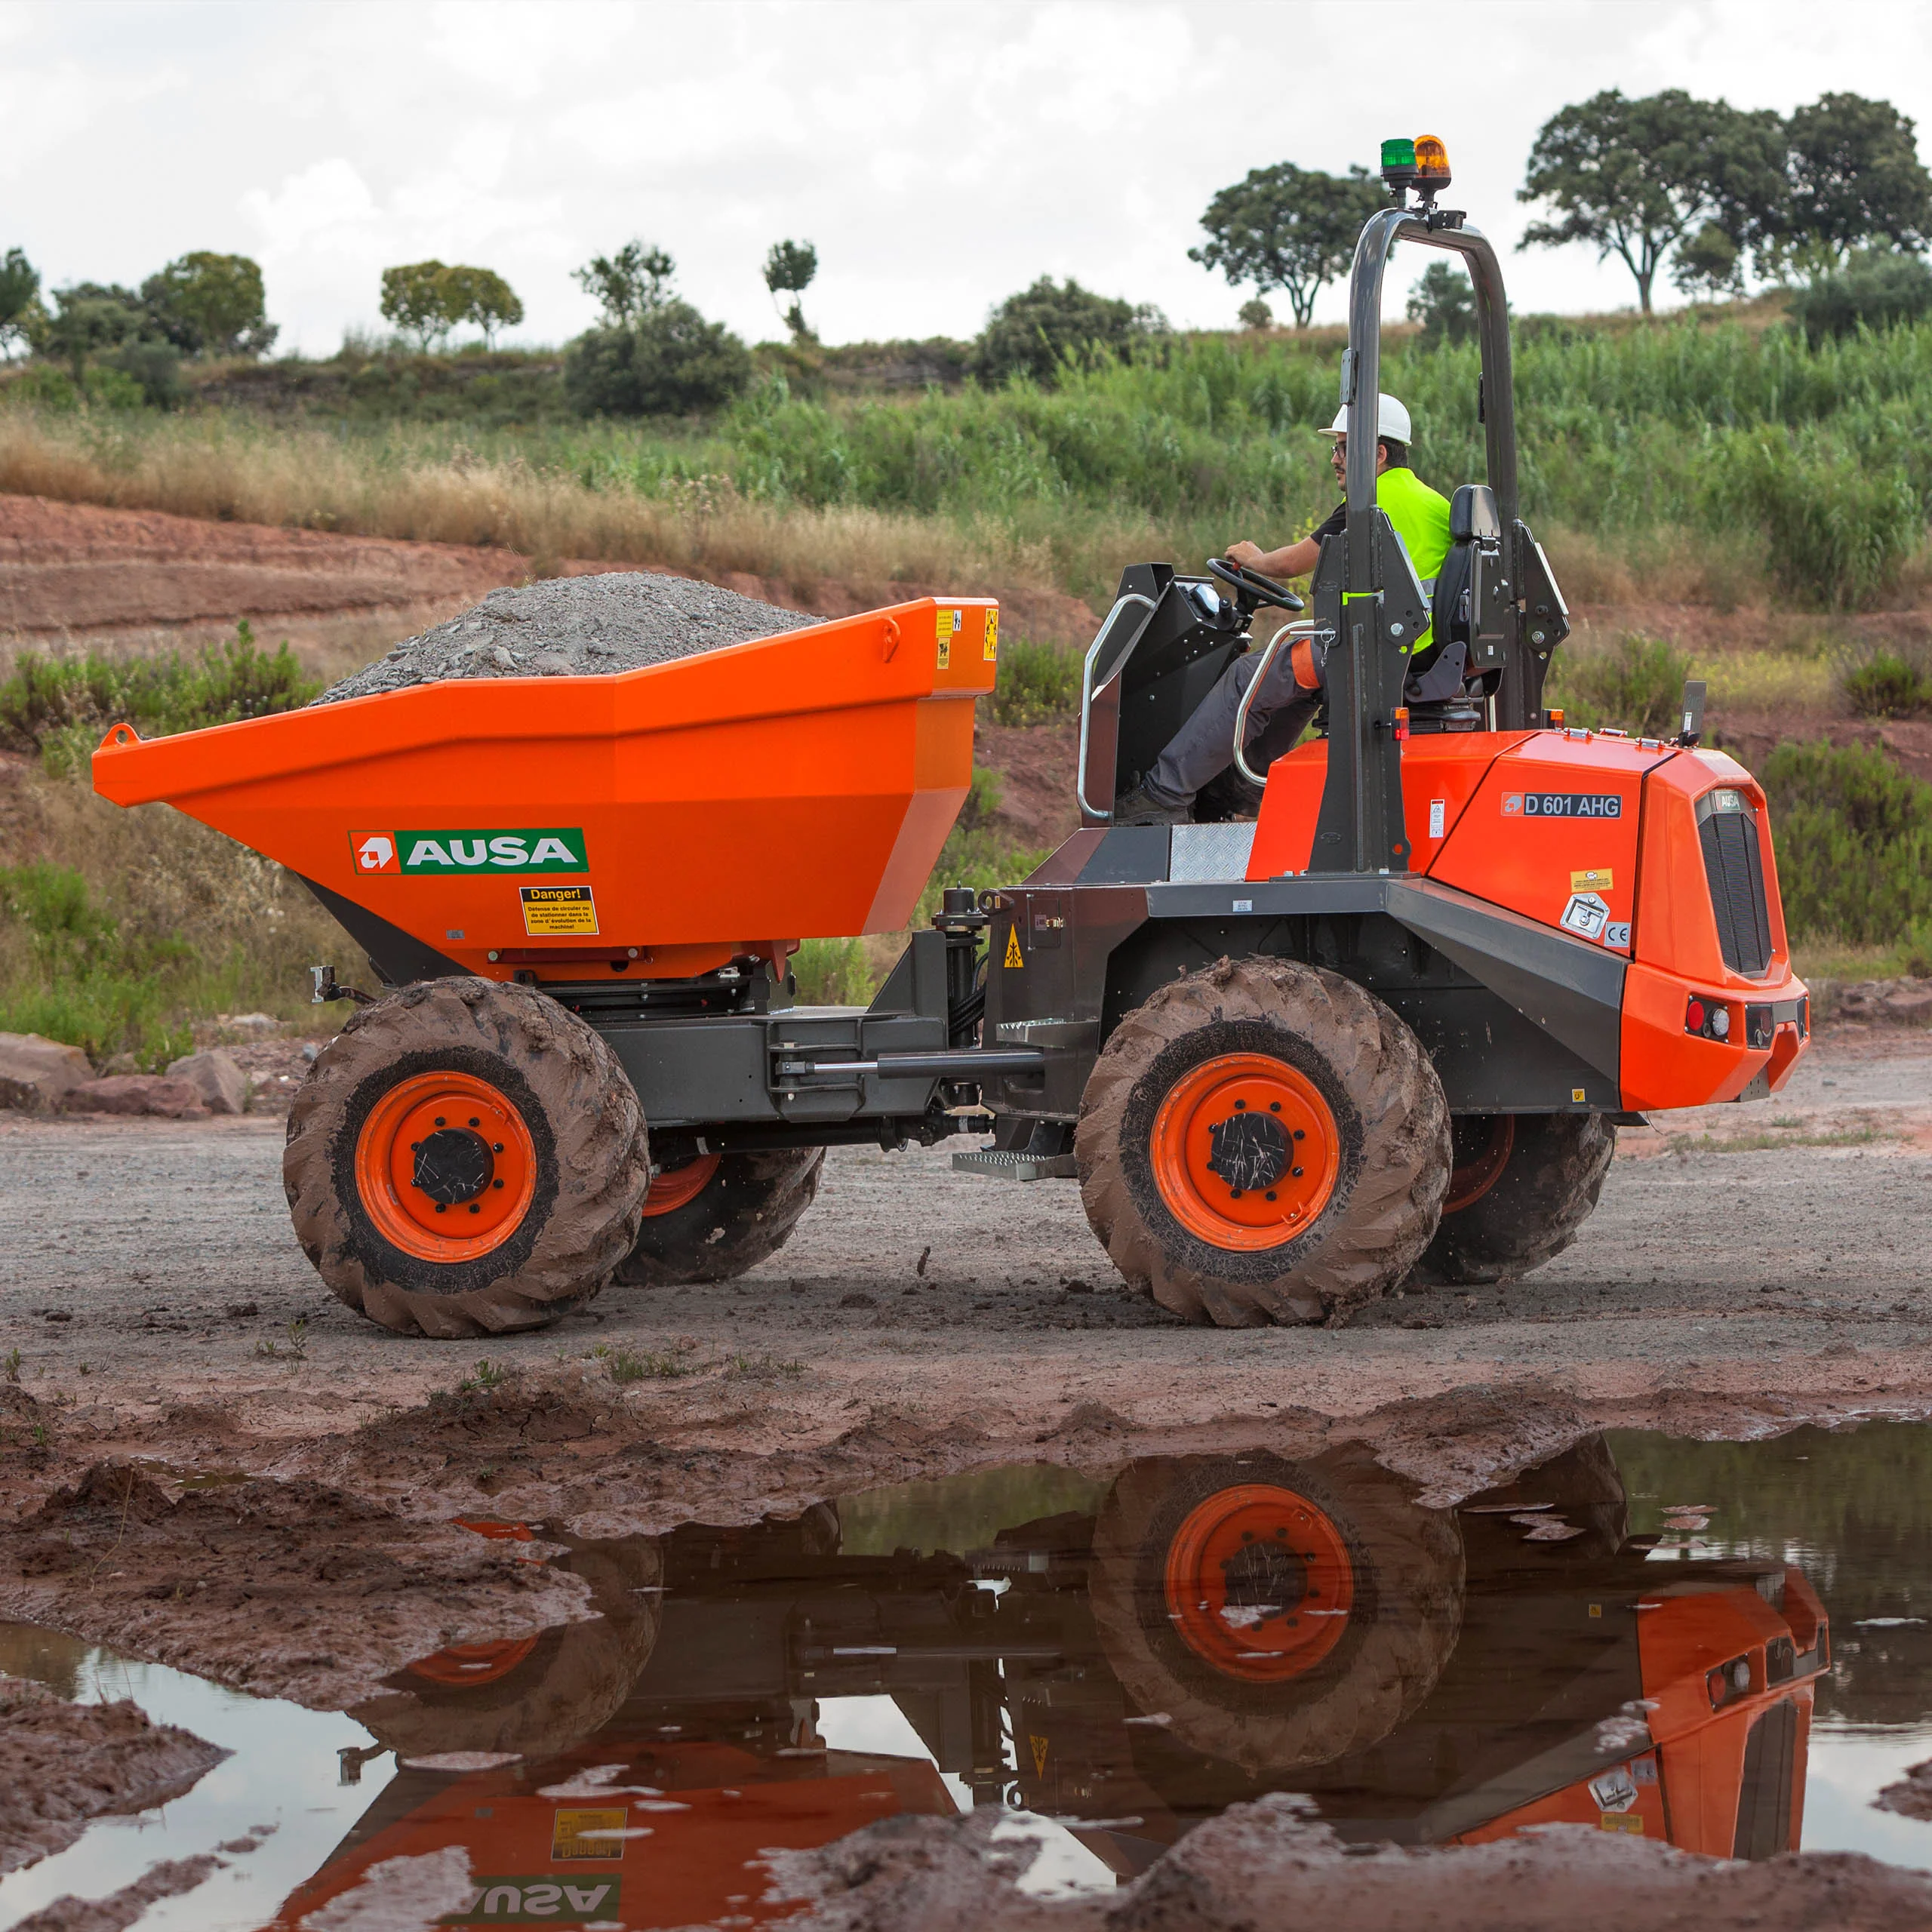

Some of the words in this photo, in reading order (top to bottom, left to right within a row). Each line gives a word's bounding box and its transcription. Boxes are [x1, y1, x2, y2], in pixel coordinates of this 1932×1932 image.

[1525, 795, 1539, 814] D
[1543, 796, 1571, 815] 601
[1577, 796, 1619, 816] AHG
[407, 837, 579, 866] AUSA
[531, 888, 581, 901] Danger!
[1607, 927, 1628, 942] CE
